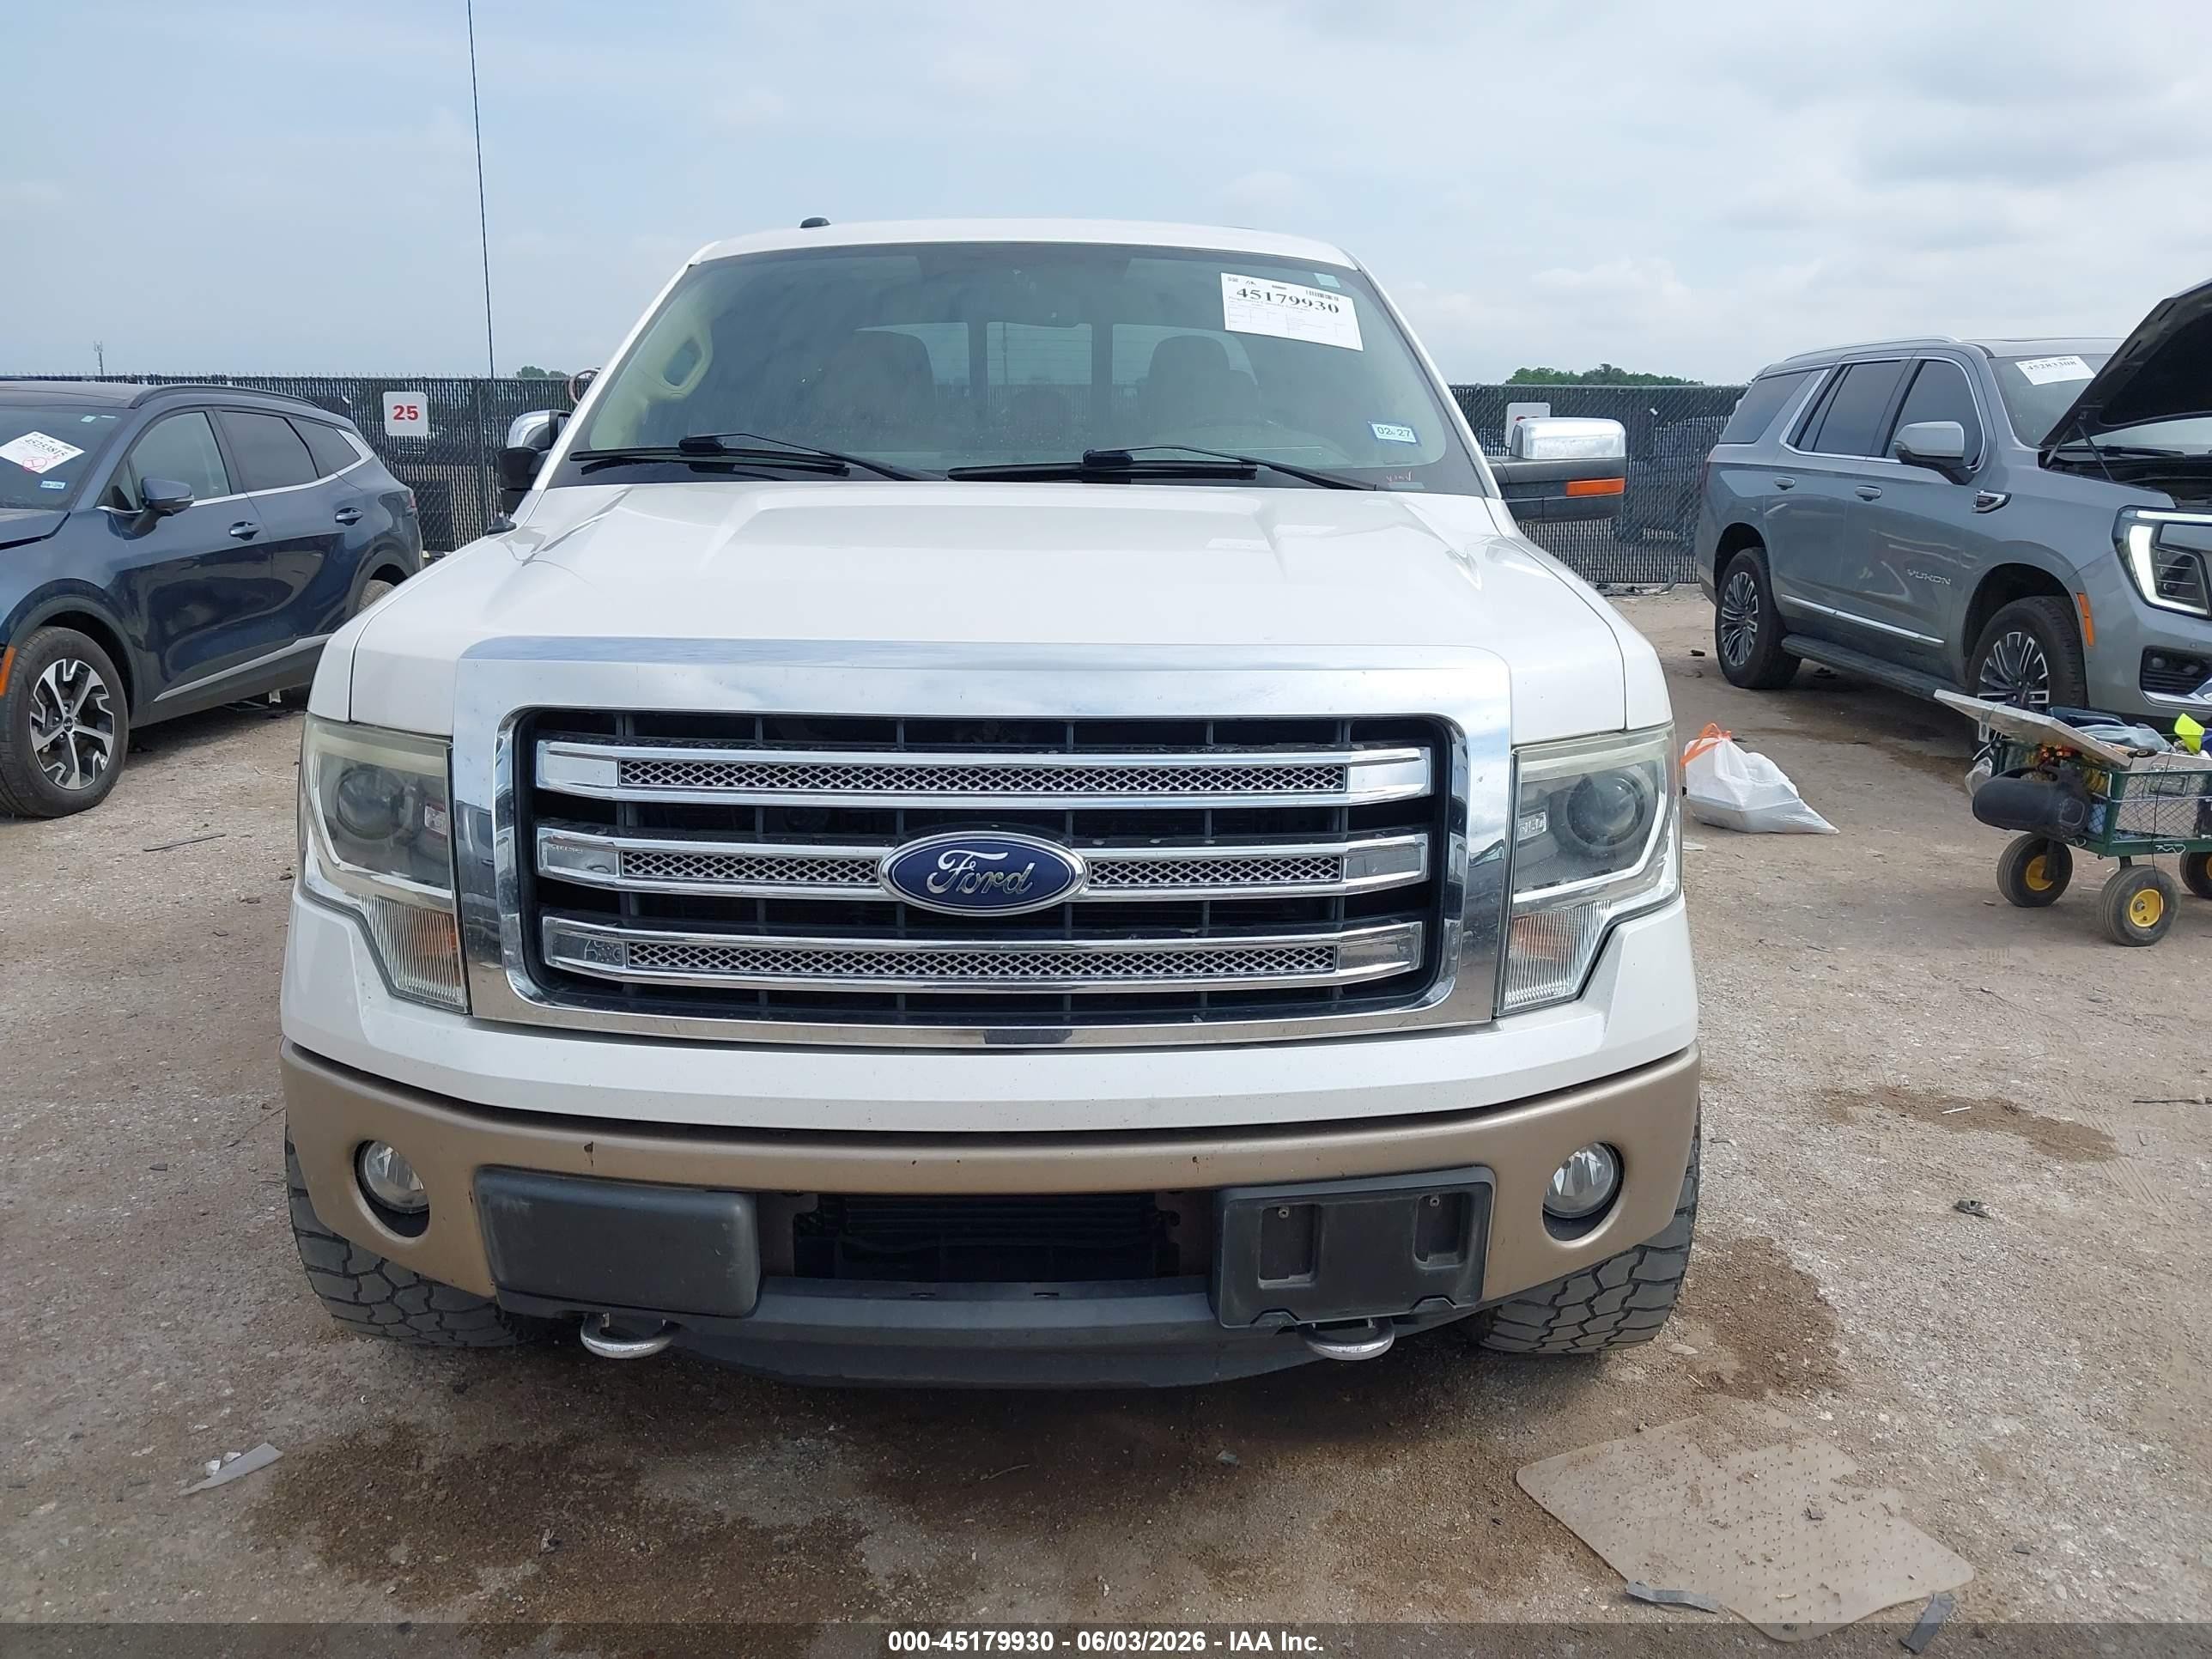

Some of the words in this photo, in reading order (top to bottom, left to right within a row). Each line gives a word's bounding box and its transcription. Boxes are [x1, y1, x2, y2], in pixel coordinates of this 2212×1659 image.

[1237, 288, 1340, 314] 45179930
[392, 404, 419, 421] 25
[1906, 568, 1952, 585] YUKON
[926, 849, 1036, 894] Ford
